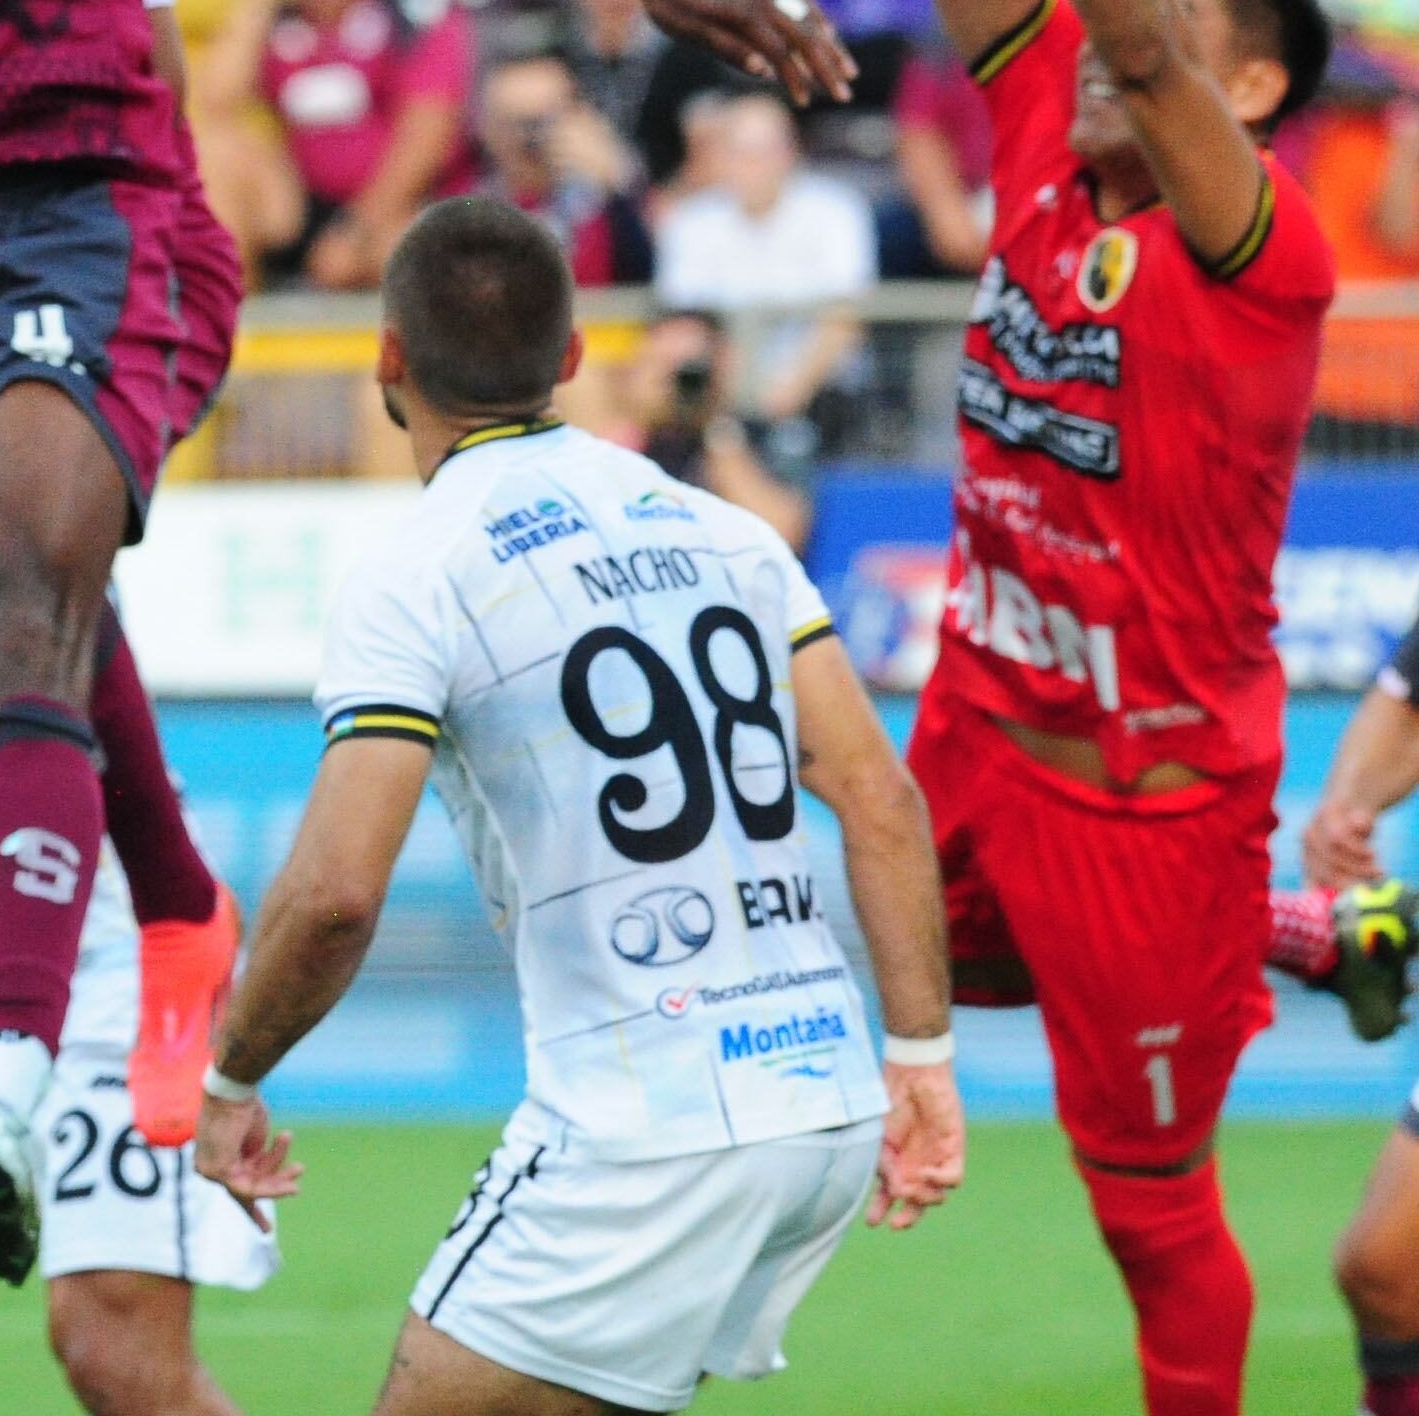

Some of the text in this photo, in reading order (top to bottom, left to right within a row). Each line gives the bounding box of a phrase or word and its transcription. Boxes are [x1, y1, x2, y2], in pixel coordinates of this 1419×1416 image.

[10, 304, 74, 367] 4
[573, 547, 700, 604] NACHO
[560, 605, 797, 864] 98
[720, 1006, 847, 1062] Montaña
[1143, 1055, 1177, 1126] 1
[53, 1109, 163, 1202] 26
